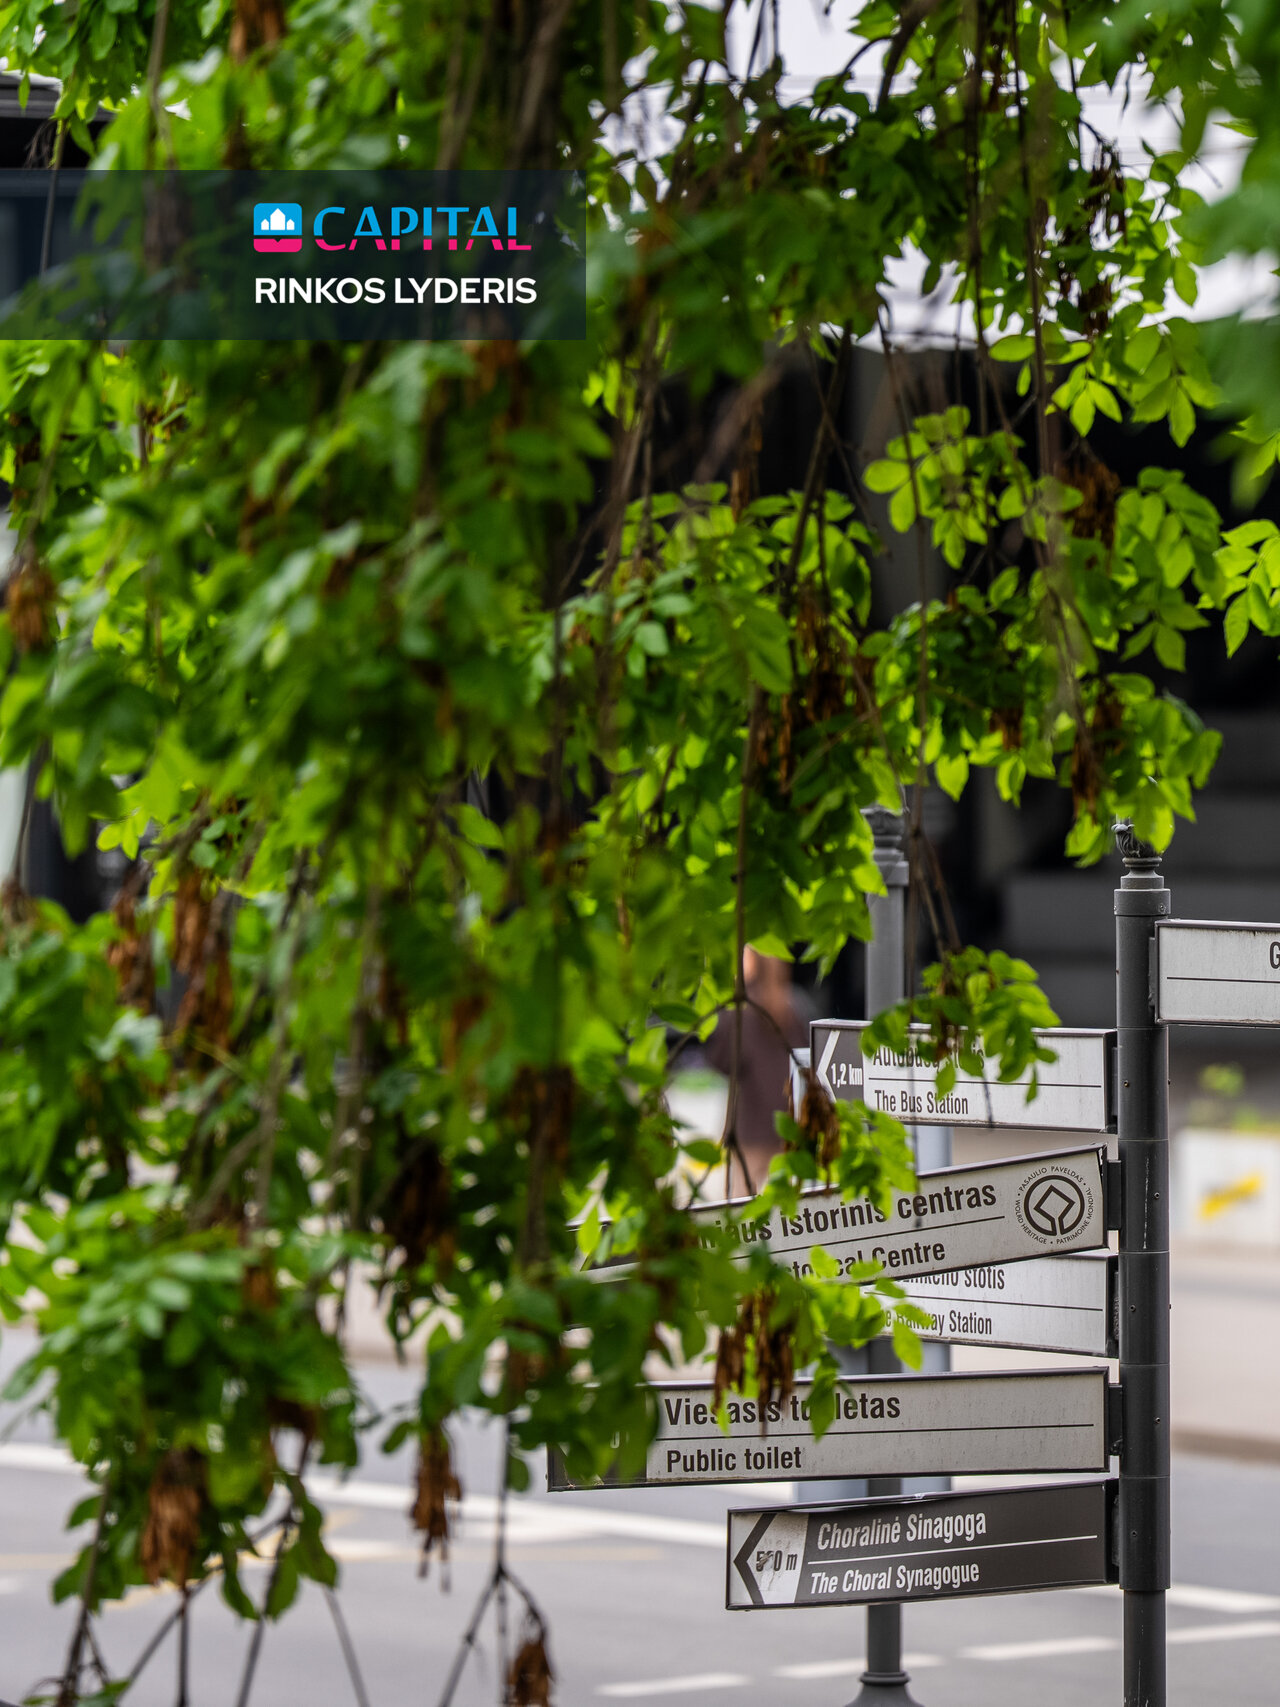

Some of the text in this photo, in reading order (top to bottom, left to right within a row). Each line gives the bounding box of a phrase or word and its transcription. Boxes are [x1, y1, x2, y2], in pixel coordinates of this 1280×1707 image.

[831, 1062, 863, 1088] 1,2 km
[874, 1090, 969, 1115] The Bus Station
[1019, 1165, 1084, 1192] PASAULIO PAVELDAS
[897, 1184, 997, 1219] centras
[1056, 1187, 1094, 1245] PATRIMOINE MONDIAL
[1021, 1223, 1048, 1245] HERITAGE
[871, 1241, 946, 1270] Centre
[964, 1265, 1005, 1290] stotis
[949, 1309, 992, 1335] Station
[790, 1392, 901, 1422] tuletas
[667, 1446, 802, 1473] Public toilet
[817, 1512, 987, 1550] Choralinė Sinagoga
[785, 1553, 798, 1571] m
[810, 1563, 980, 1595] The Choral Synagogue
